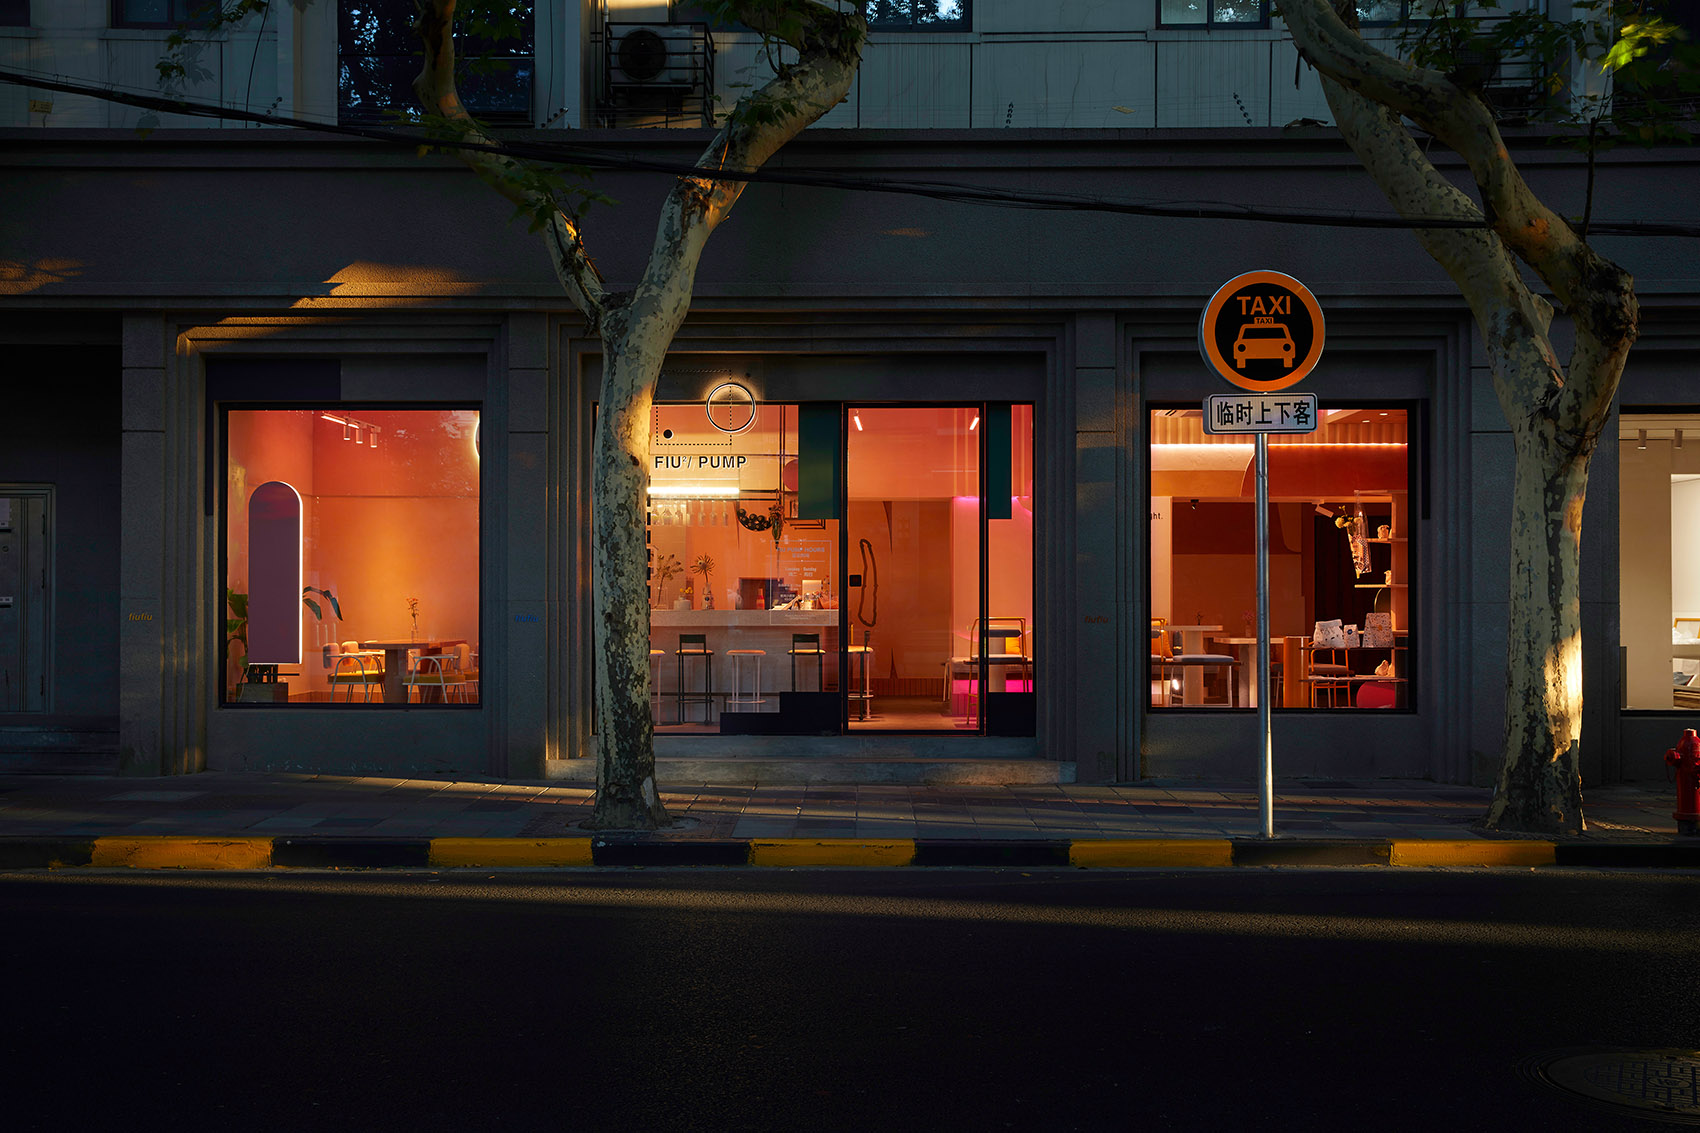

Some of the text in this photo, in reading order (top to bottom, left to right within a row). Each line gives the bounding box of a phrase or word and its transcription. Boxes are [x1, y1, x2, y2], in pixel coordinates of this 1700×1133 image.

[1237, 296, 1291, 315] TAXI
[1217, 400, 1311, 426] 临时上下客
[699, 456, 747, 468] PUMP
[128, 612, 153, 621] fiufiu
